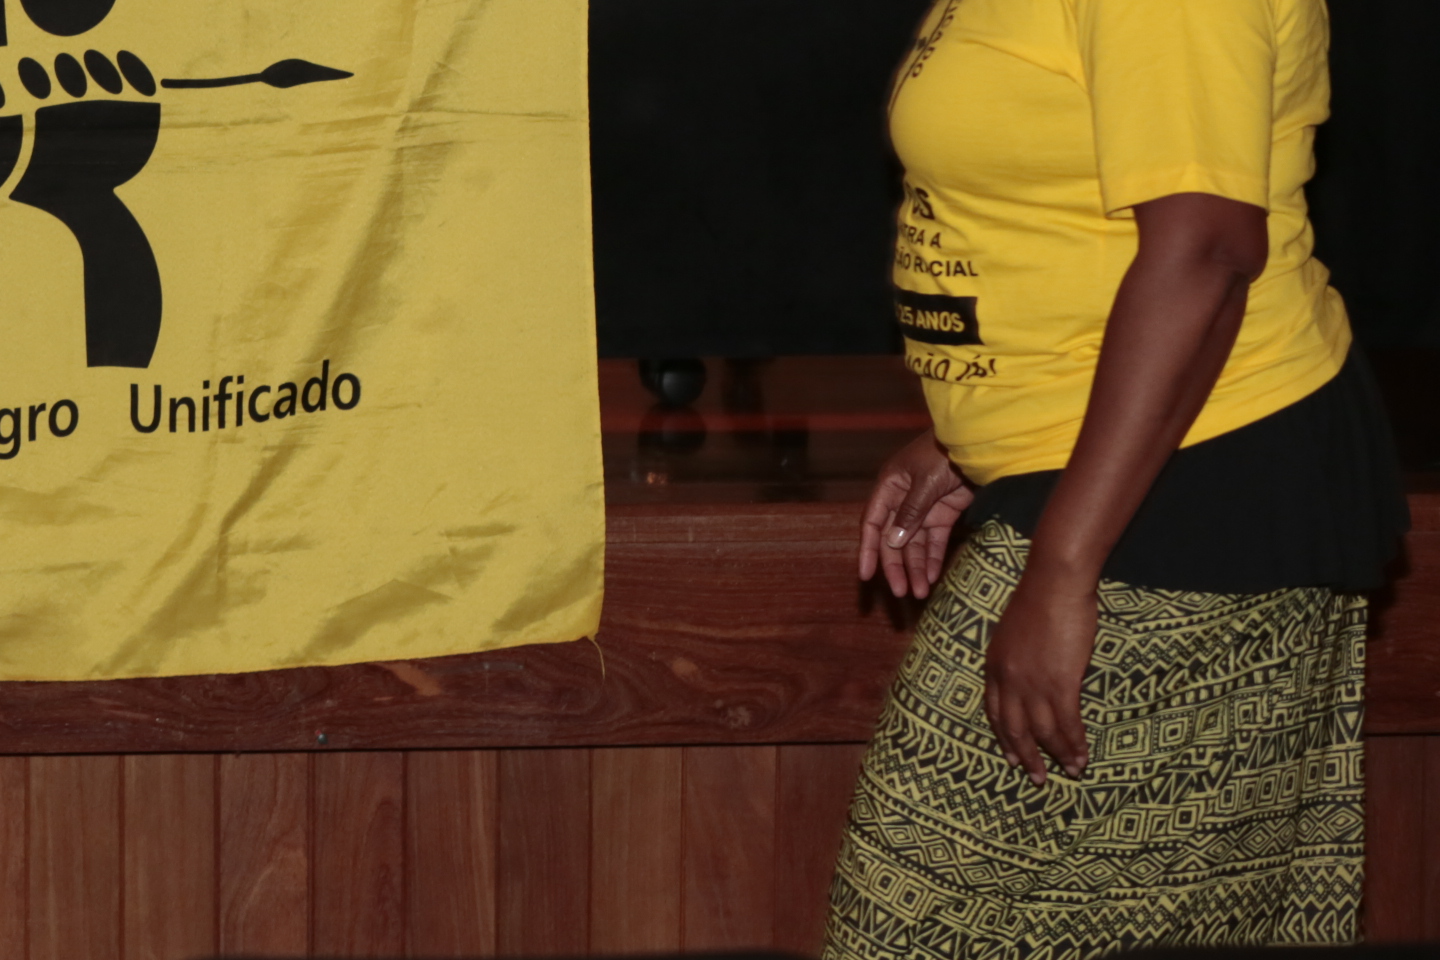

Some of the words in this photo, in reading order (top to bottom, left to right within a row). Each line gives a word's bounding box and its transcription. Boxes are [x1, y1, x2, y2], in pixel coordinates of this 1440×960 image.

[929, 231, 942, 249] A
[915, 309, 965, 333] ANOS
[129, 359, 362, 434] Unificado
